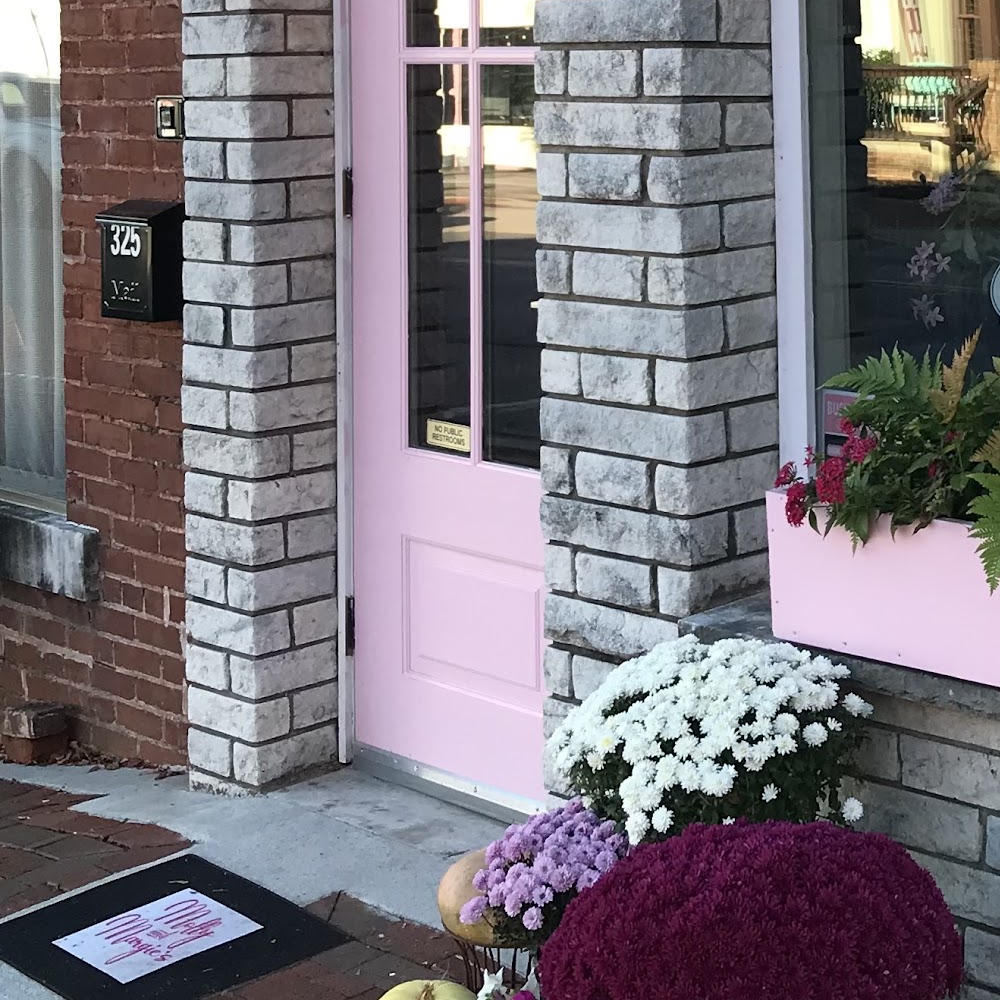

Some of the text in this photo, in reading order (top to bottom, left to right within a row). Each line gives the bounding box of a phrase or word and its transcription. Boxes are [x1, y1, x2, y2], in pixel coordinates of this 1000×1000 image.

[110, 224, 142, 258] 325
[434, 425, 463, 437] NO PUBLIC
[432, 433, 466, 446] RESTROOMS
